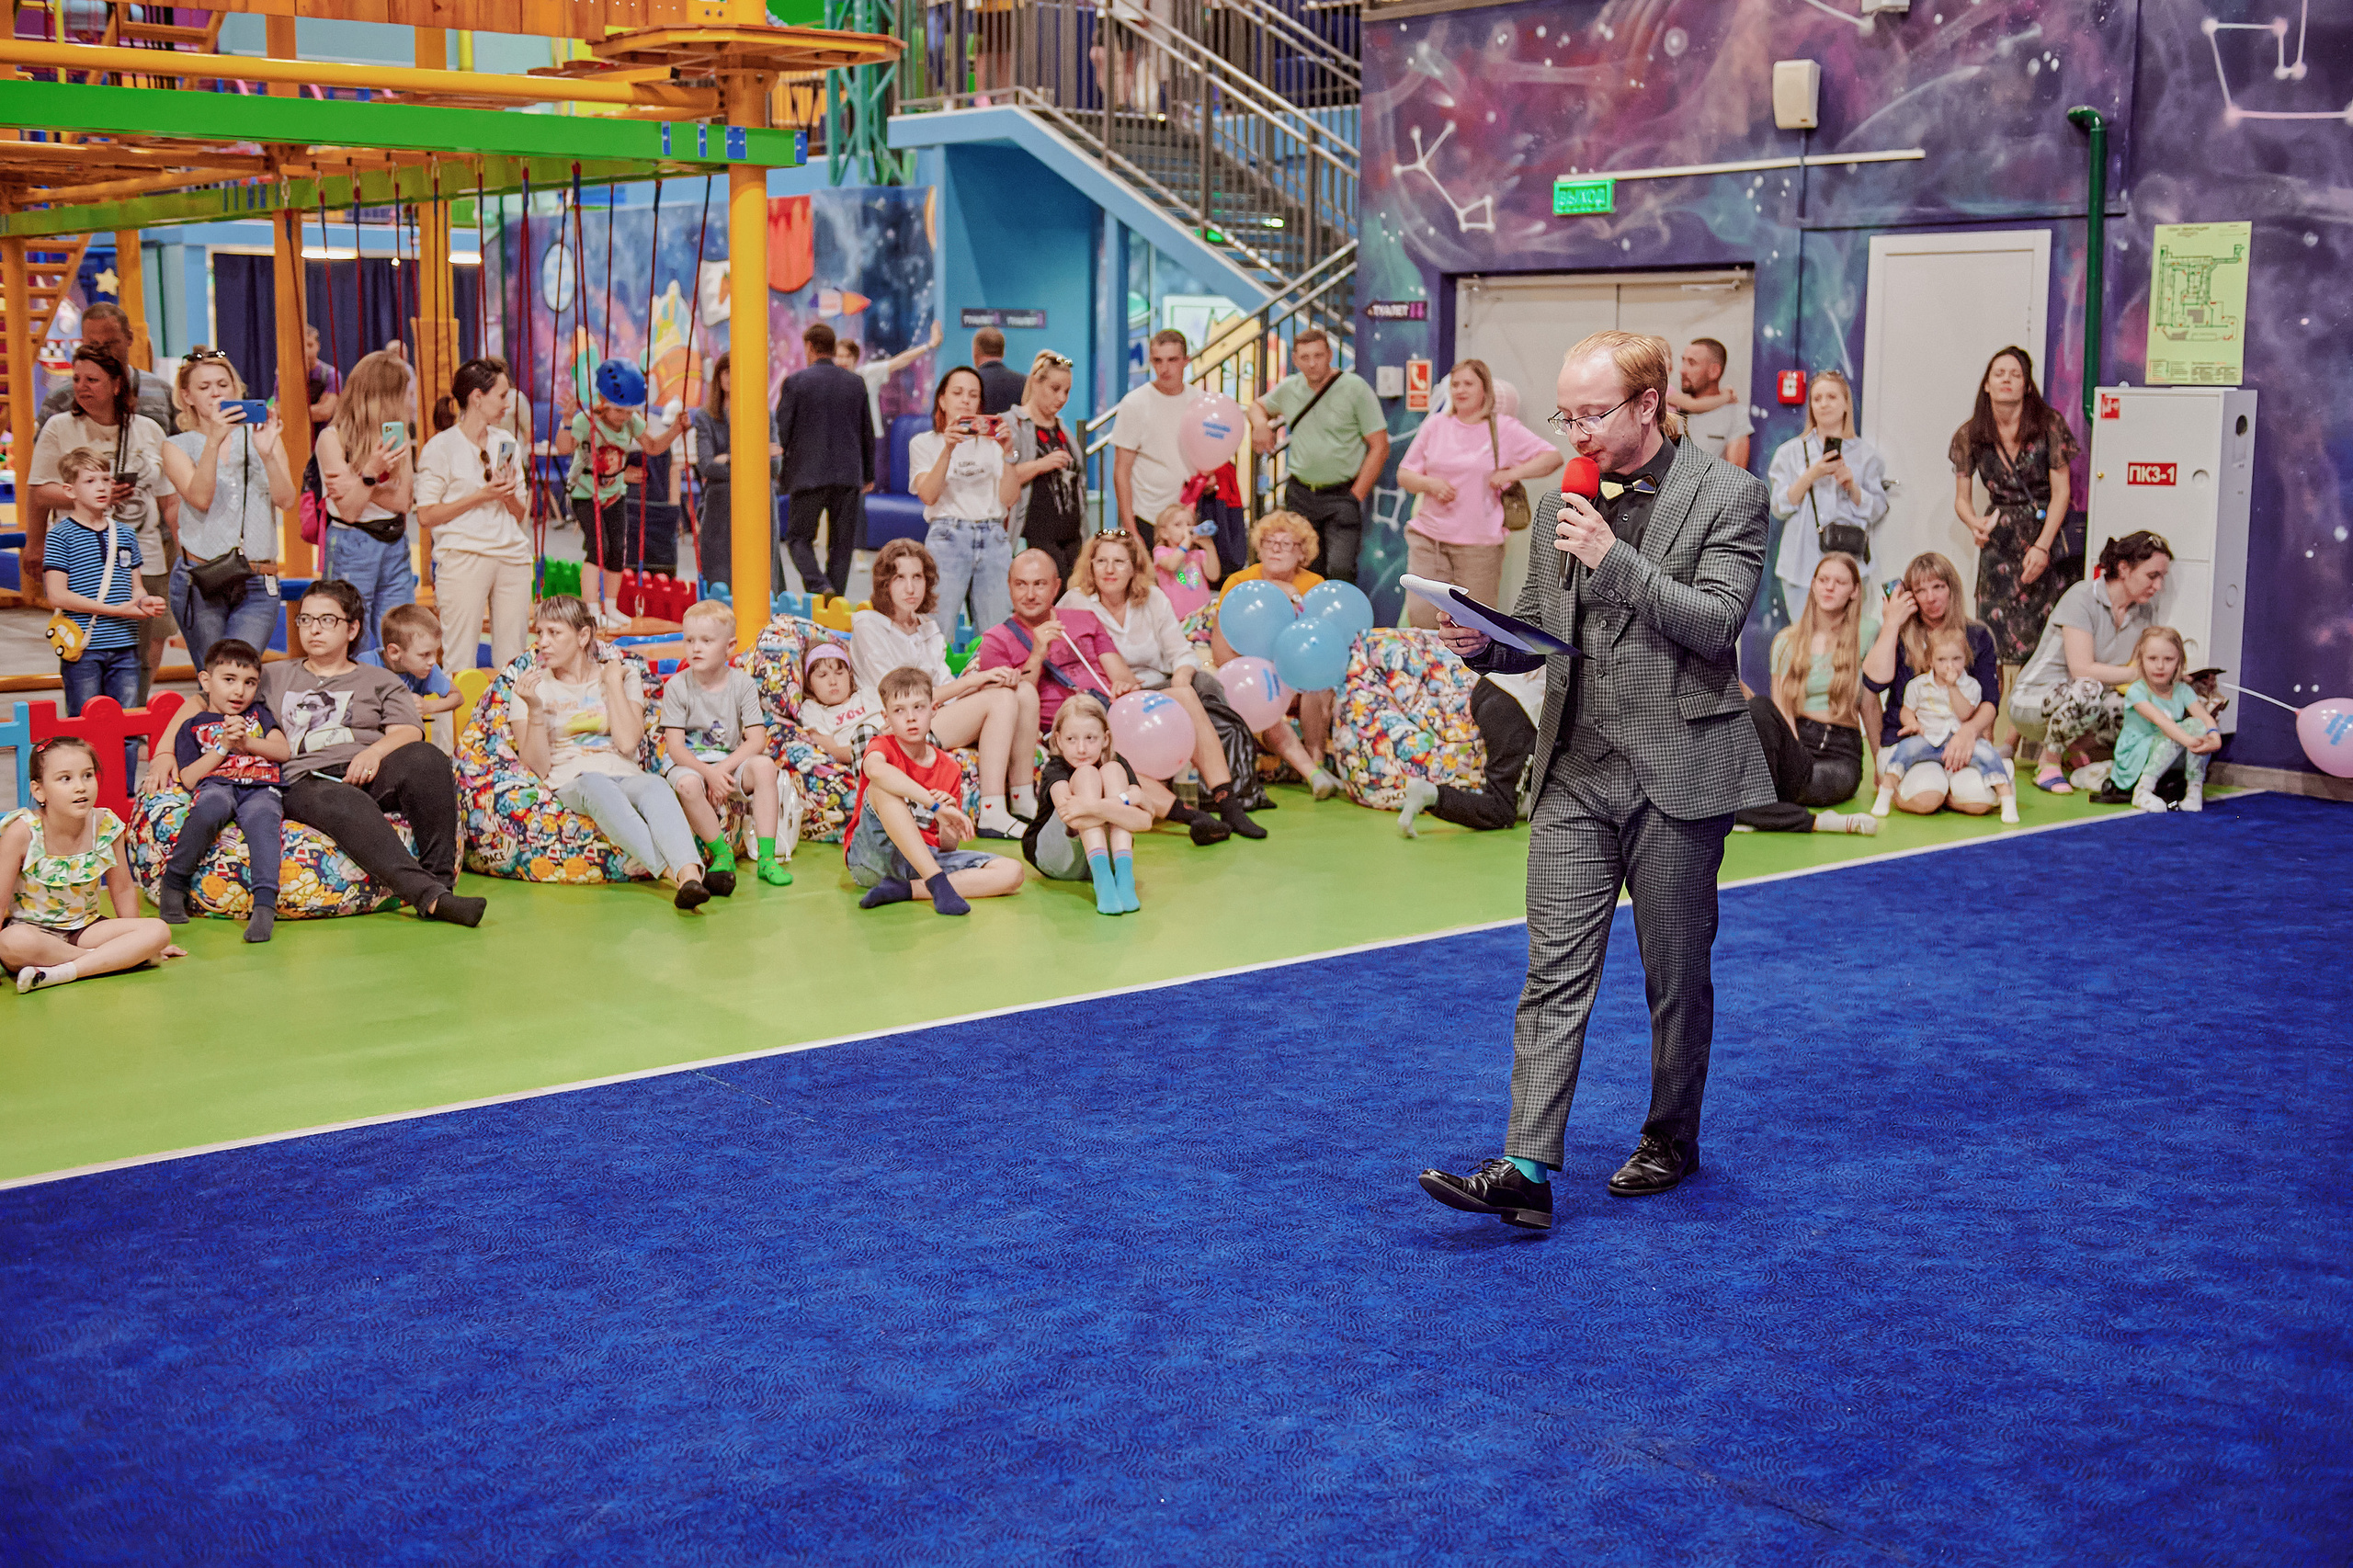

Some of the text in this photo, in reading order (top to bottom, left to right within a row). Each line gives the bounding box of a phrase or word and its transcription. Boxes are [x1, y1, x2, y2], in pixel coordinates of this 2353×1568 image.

[1558, 188, 1606, 206] ВЫХОД
[835, 706, 867, 726] you
[479, 851, 506, 865] SPACE
